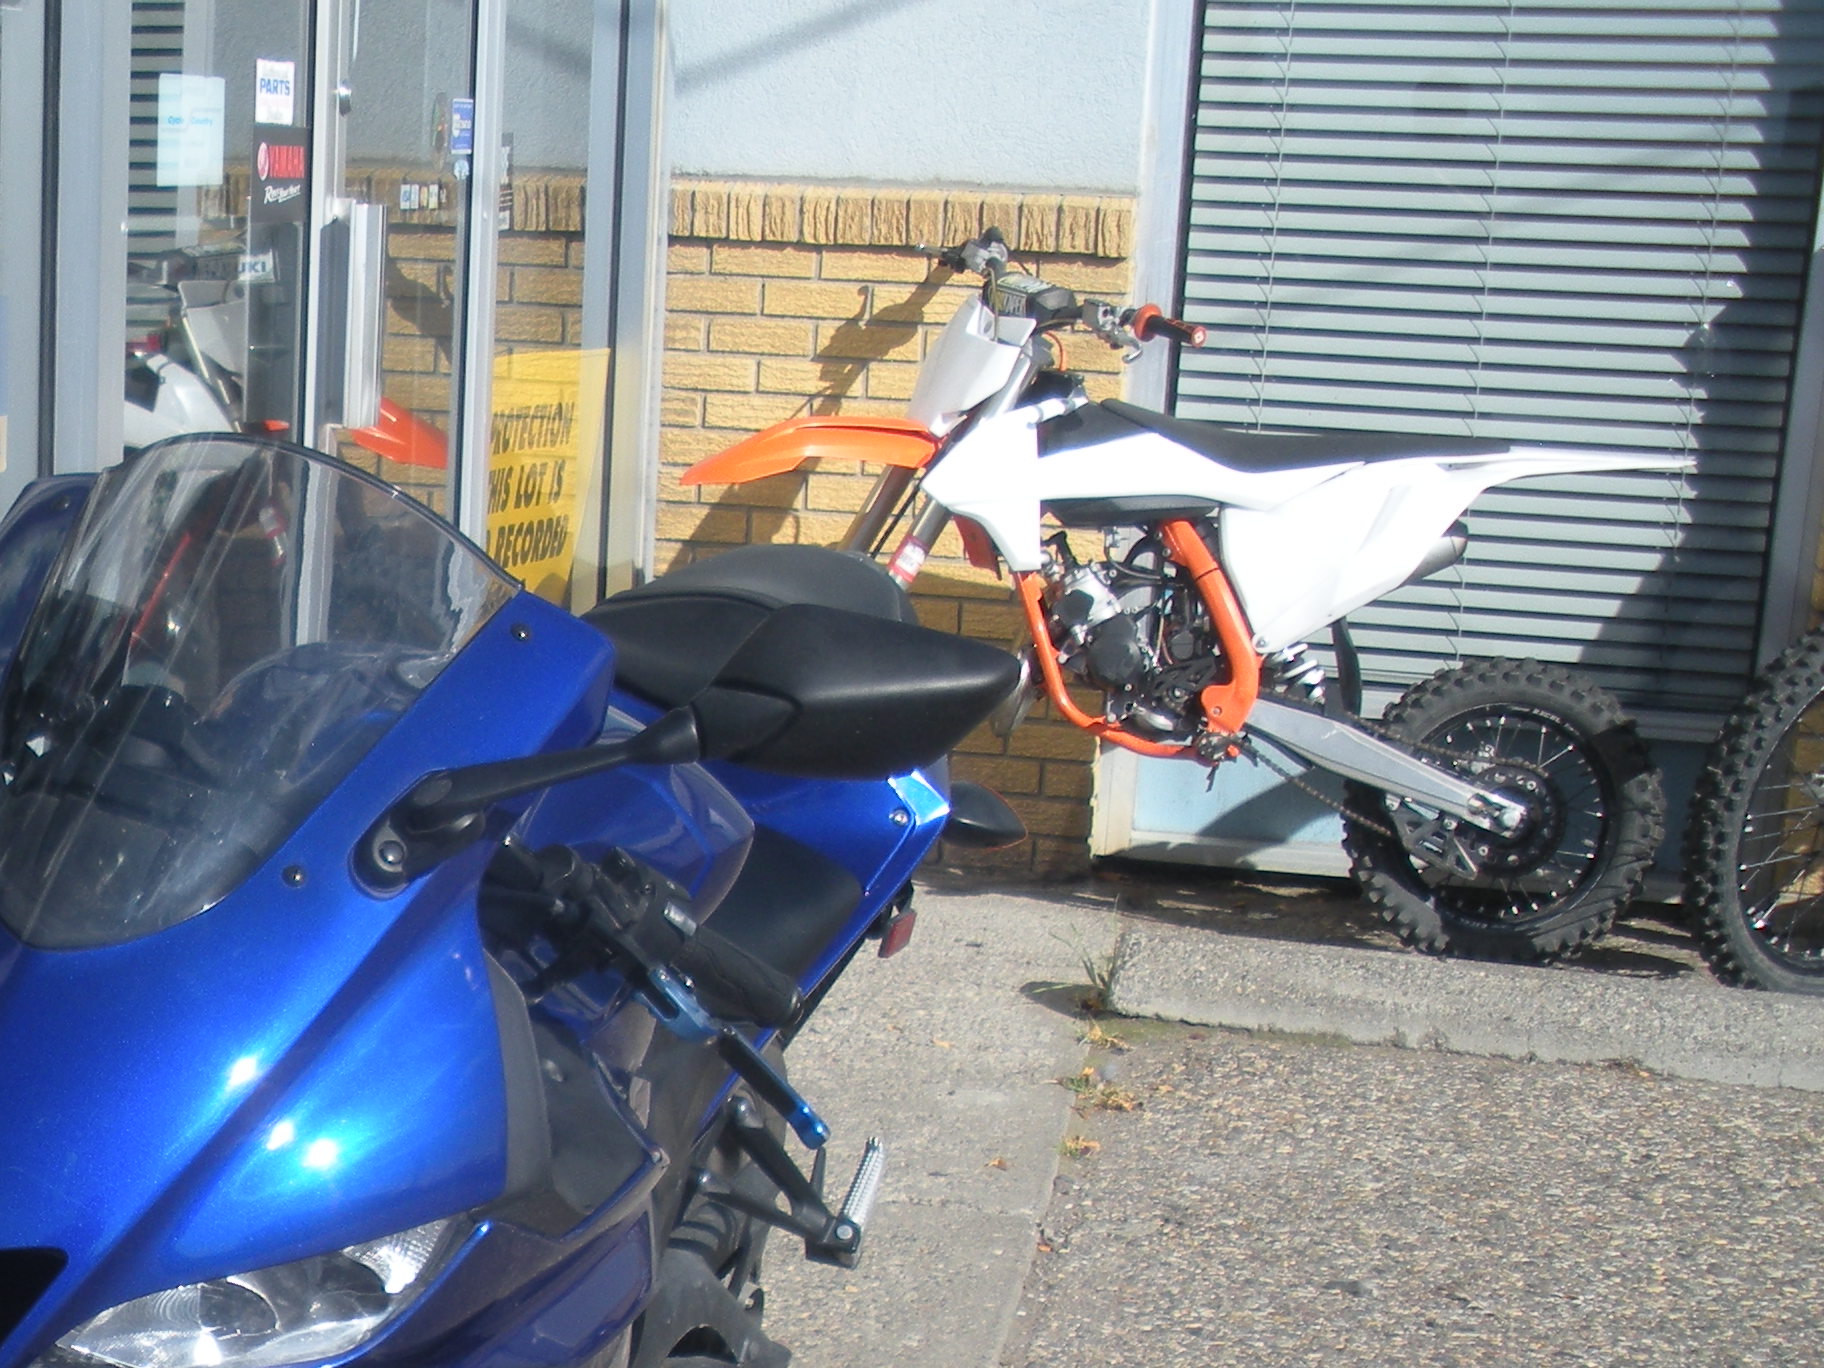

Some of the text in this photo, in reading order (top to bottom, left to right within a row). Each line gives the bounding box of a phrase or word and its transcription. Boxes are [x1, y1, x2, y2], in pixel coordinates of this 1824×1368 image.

[260, 78, 290, 96] PARTS
[514, 462, 548, 509] LOT
[547, 459, 566, 504] IS
[494, 514, 569, 568] RECORDED
